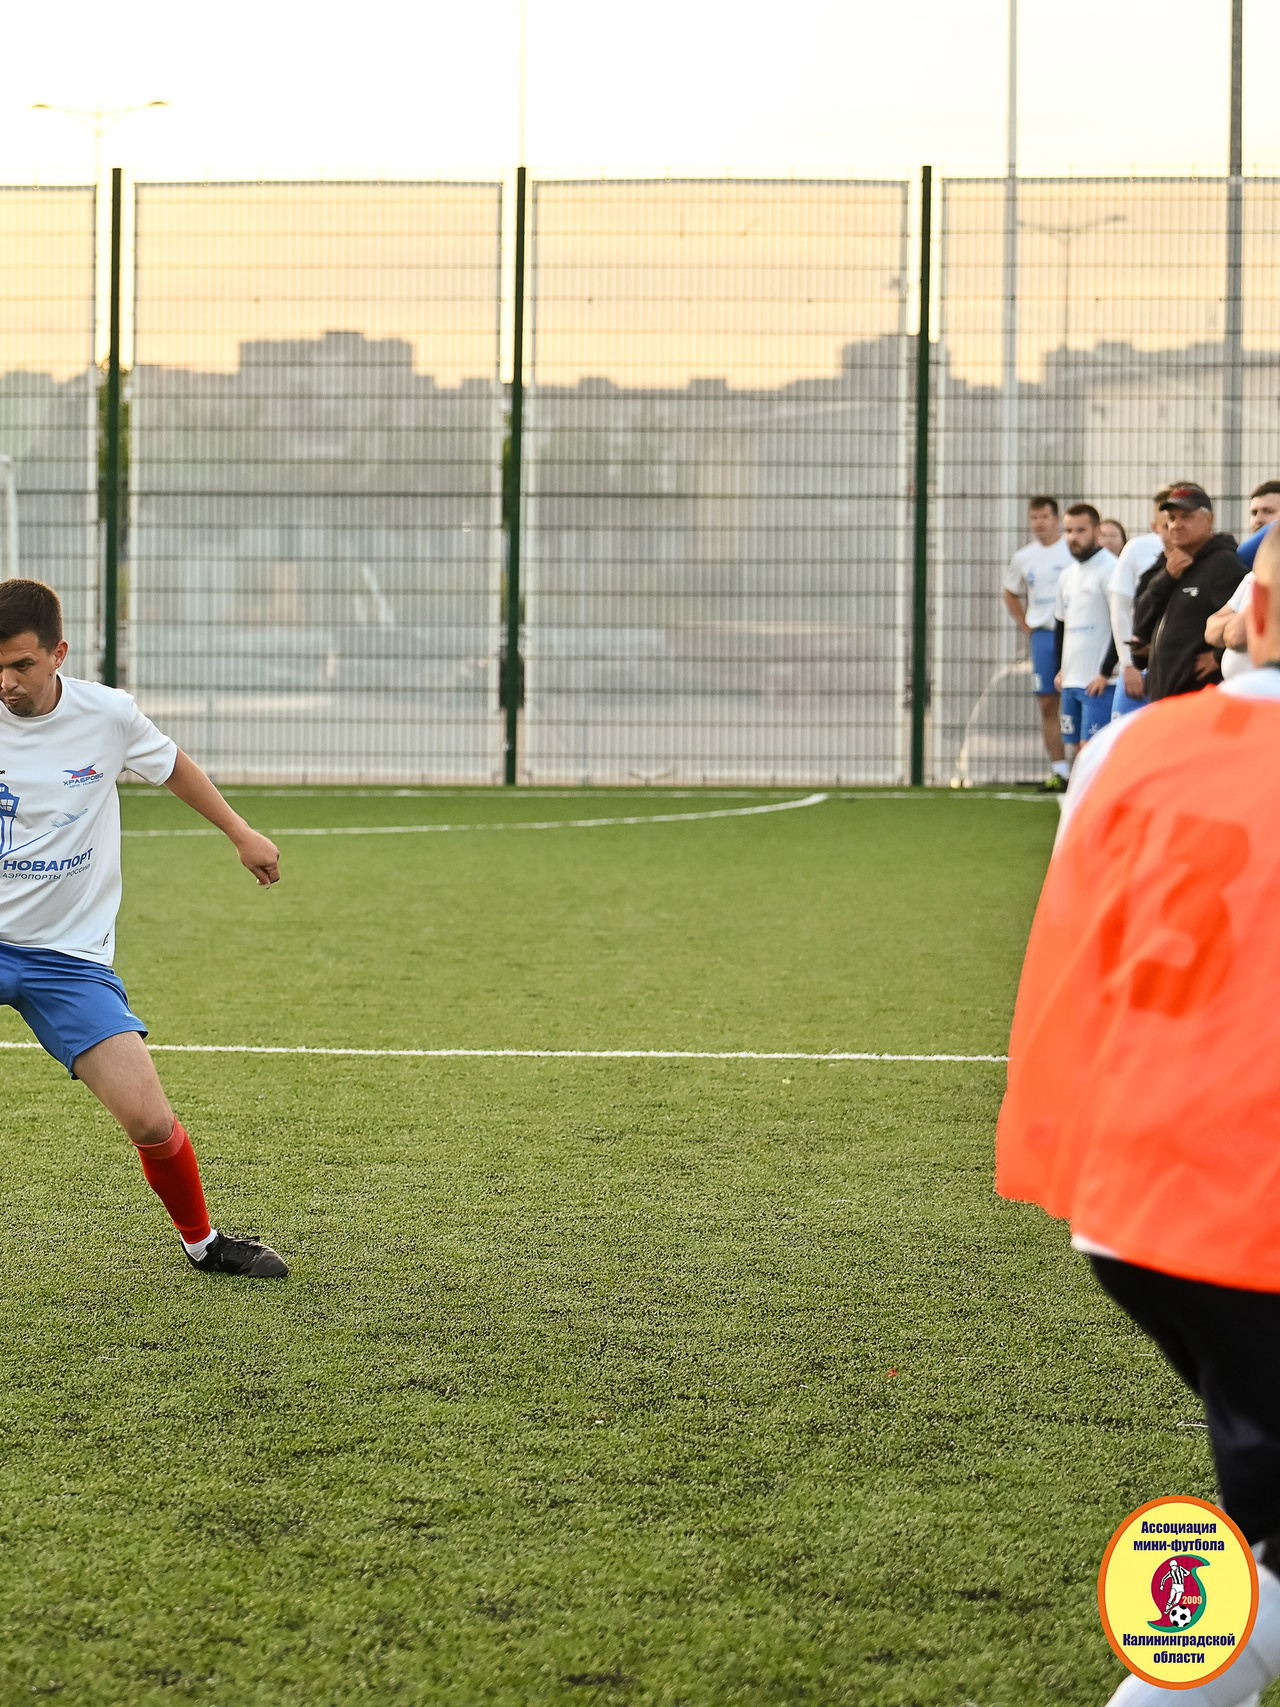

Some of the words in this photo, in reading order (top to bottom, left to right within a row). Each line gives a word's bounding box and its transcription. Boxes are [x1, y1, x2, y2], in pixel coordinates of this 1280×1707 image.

[3, 847, 93, 872] НОВАПОРТ
[2, 872, 62, 881] АЭРОПОРТЫ
[65, 863, 91, 878] РОССИИ
